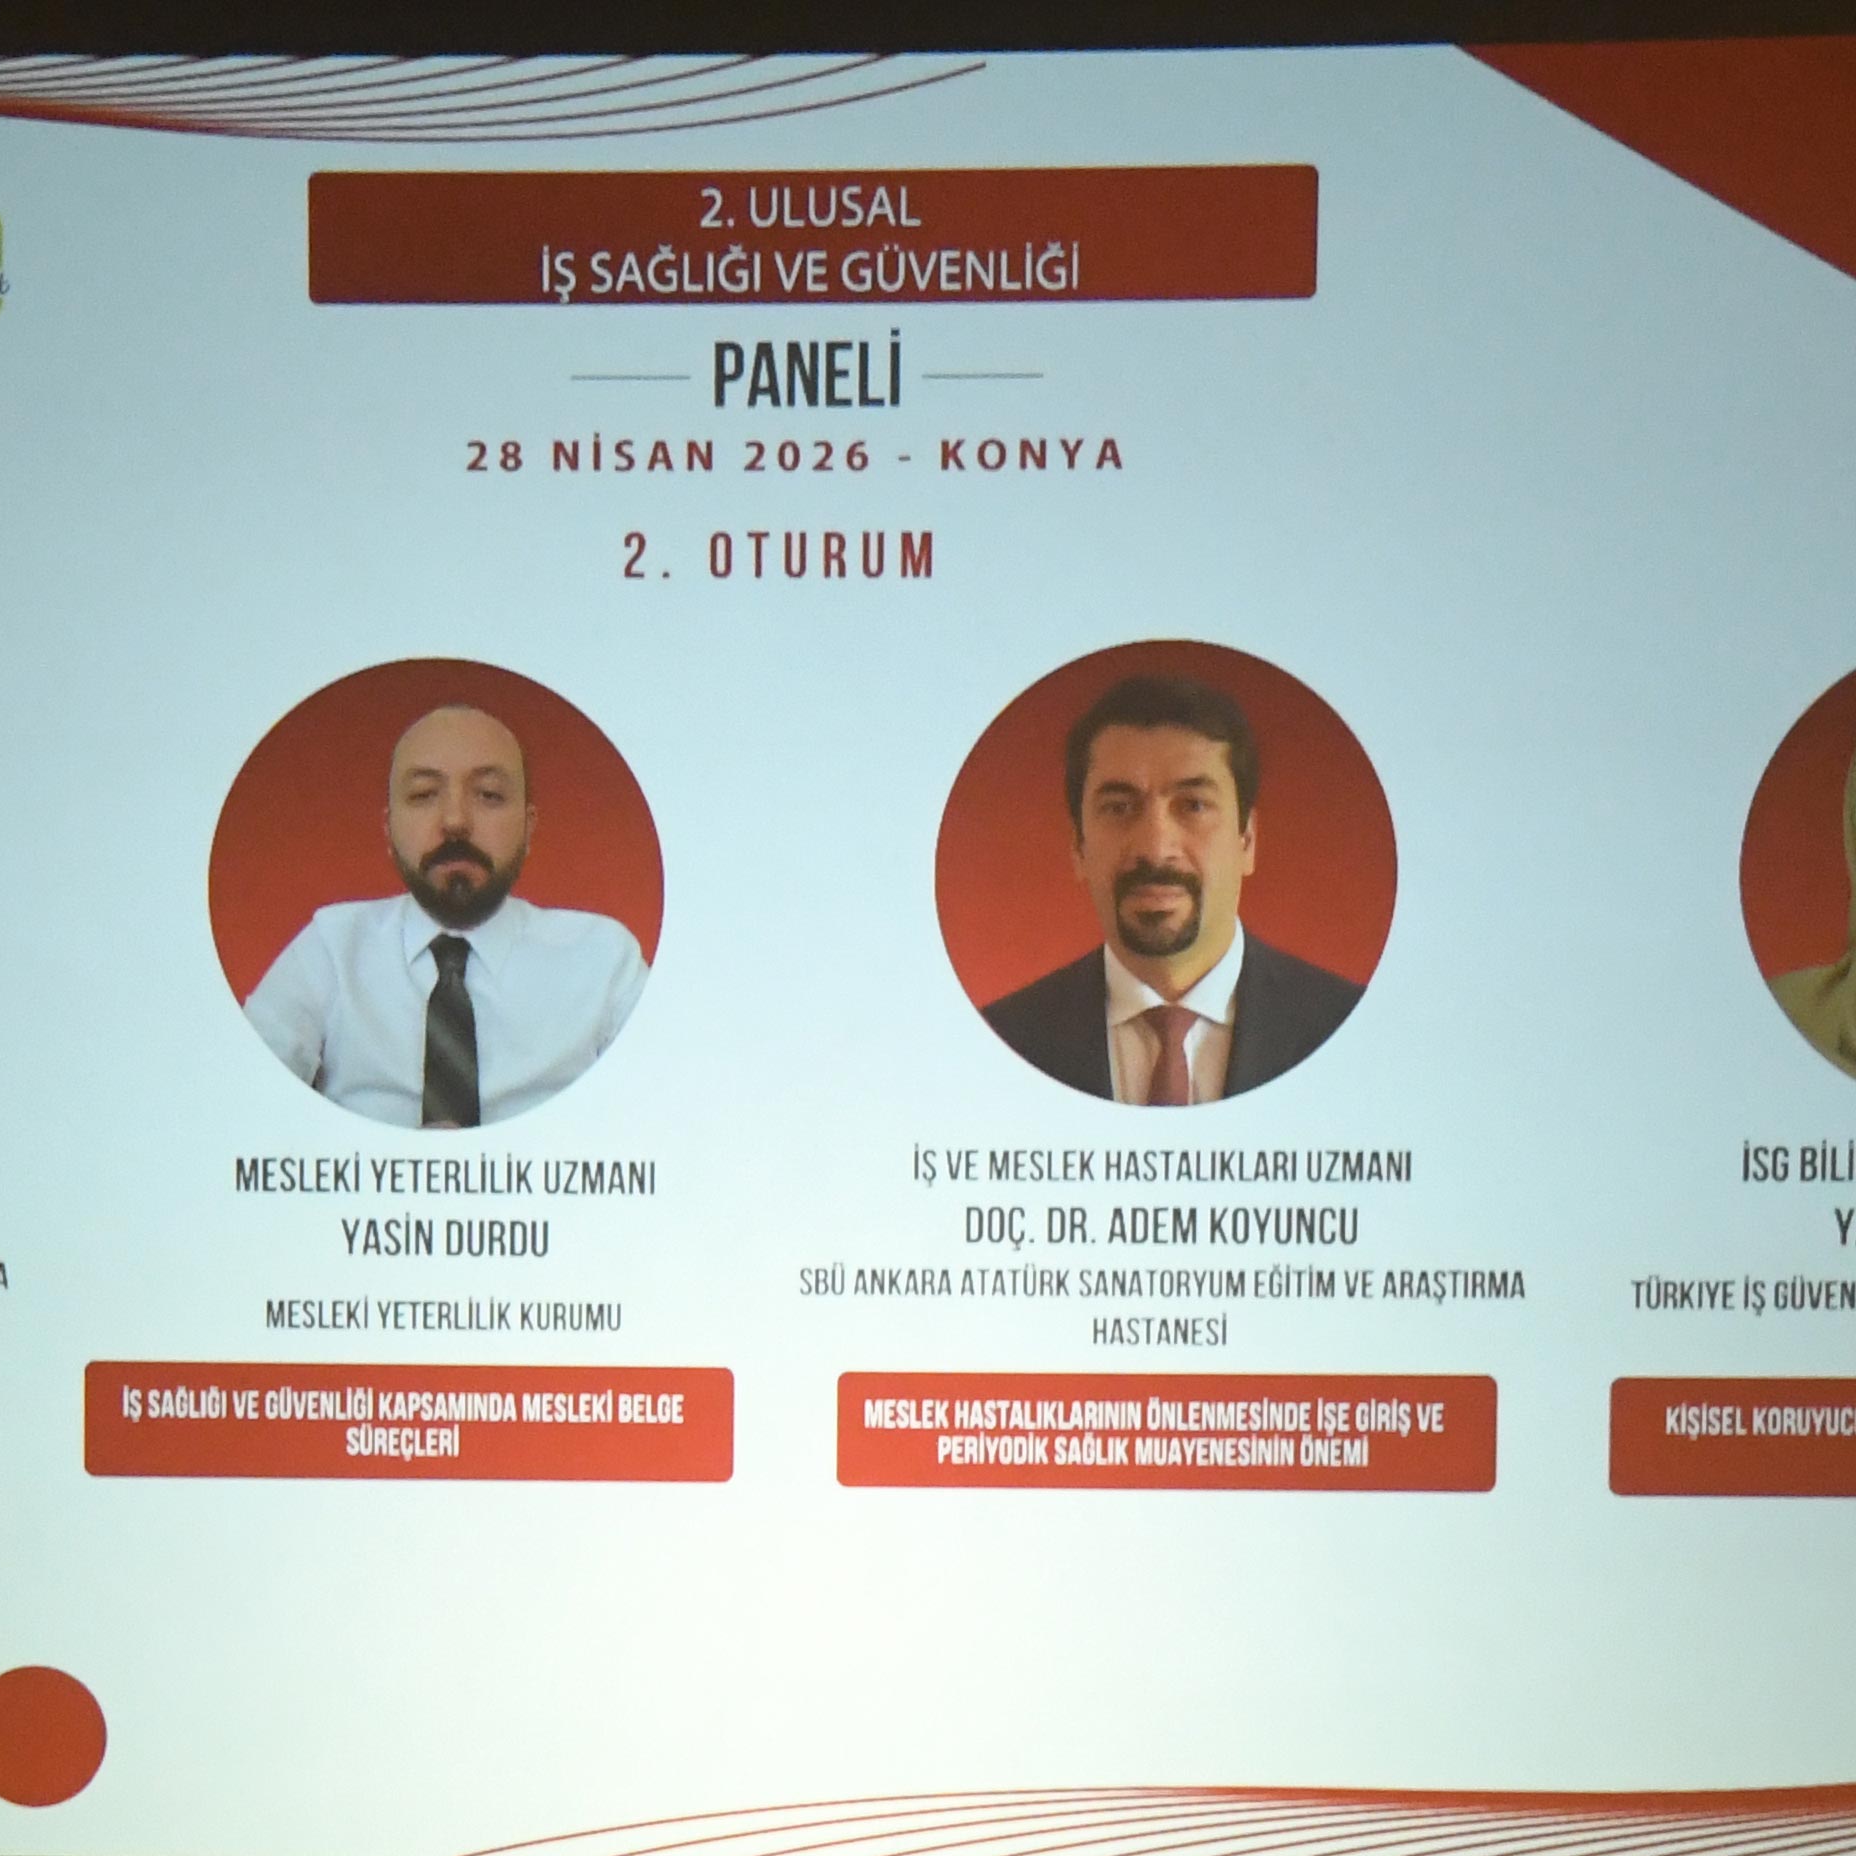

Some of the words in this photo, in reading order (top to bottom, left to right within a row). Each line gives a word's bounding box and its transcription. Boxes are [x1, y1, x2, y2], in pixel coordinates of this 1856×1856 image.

[700, 187, 735, 228] 2.
[750, 185, 922, 228] ULUSAL
[542, 245, 577, 304] İŞ
[590, 244, 761, 294] SAĞLIĞI
[774, 250, 828, 292] VE
[841, 242, 1081, 294] GÜVENLİĞİ
[714, 328, 901, 408] PANELİ
[466, 439, 523, 473] 28
[553, 432, 713, 473] NİSAN
[743, 439, 869, 473] 2026
[940, 437, 1123, 472] KONYA
[624, 531, 670, 579] 2.
[709, 531, 933, 579] OTURUM
[235, 1151, 360, 1193] MESLEKİ
[370, 1153, 533, 1195] YETERLİLİK
[544, 1160, 656, 1196] UZMANI
[914, 1143, 937, 1185] İŞ
[946, 1149, 979, 1181] VE
[989, 1150, 1095, 1182] MESLEK
[1105, 1149, 1297, 1183] HASTALIKLARI
[1306, 1149, 1412, 1183] UZMANI
[1742, 1140, 1790, 1182] İSG
[341, 1212, 433, 1257] YASİN
[446, 1219, 549, 1258] DURDU
[965, 1206, 1035, 1251] DOÇ.
[1047, 1207, 1096, 1244] DR.
[1107, 1207, 1197, 1244] ADEM
[1209, 1207, 1358, 1245] KOYUNCU
[799, 1263, 845, 1296] SBÜ
[854, 1268, 952, 1296] ANKARA
[960, 1263, 1070, 1297] ATATÜRK
[1079, 1268, 1246, 1299] SANATORYUM
[1254, 1264, 1336, 1299] EĞİTİM
[1344, 1269, 1373, 1299] VE
[1382, 1269, 1526, 1305] ARAŞTIRMA
[1743, 1275, 1766, 1316] İŞ
[266, 1296, 369, 1330] MESLEKİ
[377, 1297, 511, 1331] YETERLİLİK
[520, 1301, 622, 1332] KURUMU
[1092, 1313, 1227, 1346] HASTANESİ
[122, 1385, 143, 1423] İŞ
[147, 1385, 227, 1419] SAĞLIĞI
[232, 1389, 260, 1421] VE
[264, 1386, 374, 1422] GÜVENLİĞİ
[378, 1391, 518, 1423] KAPSAMINDA
[522, 1388, 613, 1424] MESLEKİ
[618, 1393, 684, 1425] BELGE
[864, 1398, 949, 1430] MESLEK
[954, 1398, 1142, 1431] HASTALIKLARININ
[1146, 1395, 1313, 1432] ÖNLENMESİNDE
[1317, 1397, 1351, 1437] İŞE
[1355, 1398, 1411, 1438] GİRİŞ
[1416, 1402, 1444, 1433] VE
[1665, 1402, 1748, 1441] KİŞİSEL
[346, 1423, 460, 1462] SÜREÇLERİ
[937, 1431, 1049, 1466] PERİYODİK
[1054, 1431, 1129, 1466] SAĞLIK
[1134, 1432, 1295, 1467] MUAYENESİNİN
[1299, 1430, 1369, 1467] ÖNEMİ
